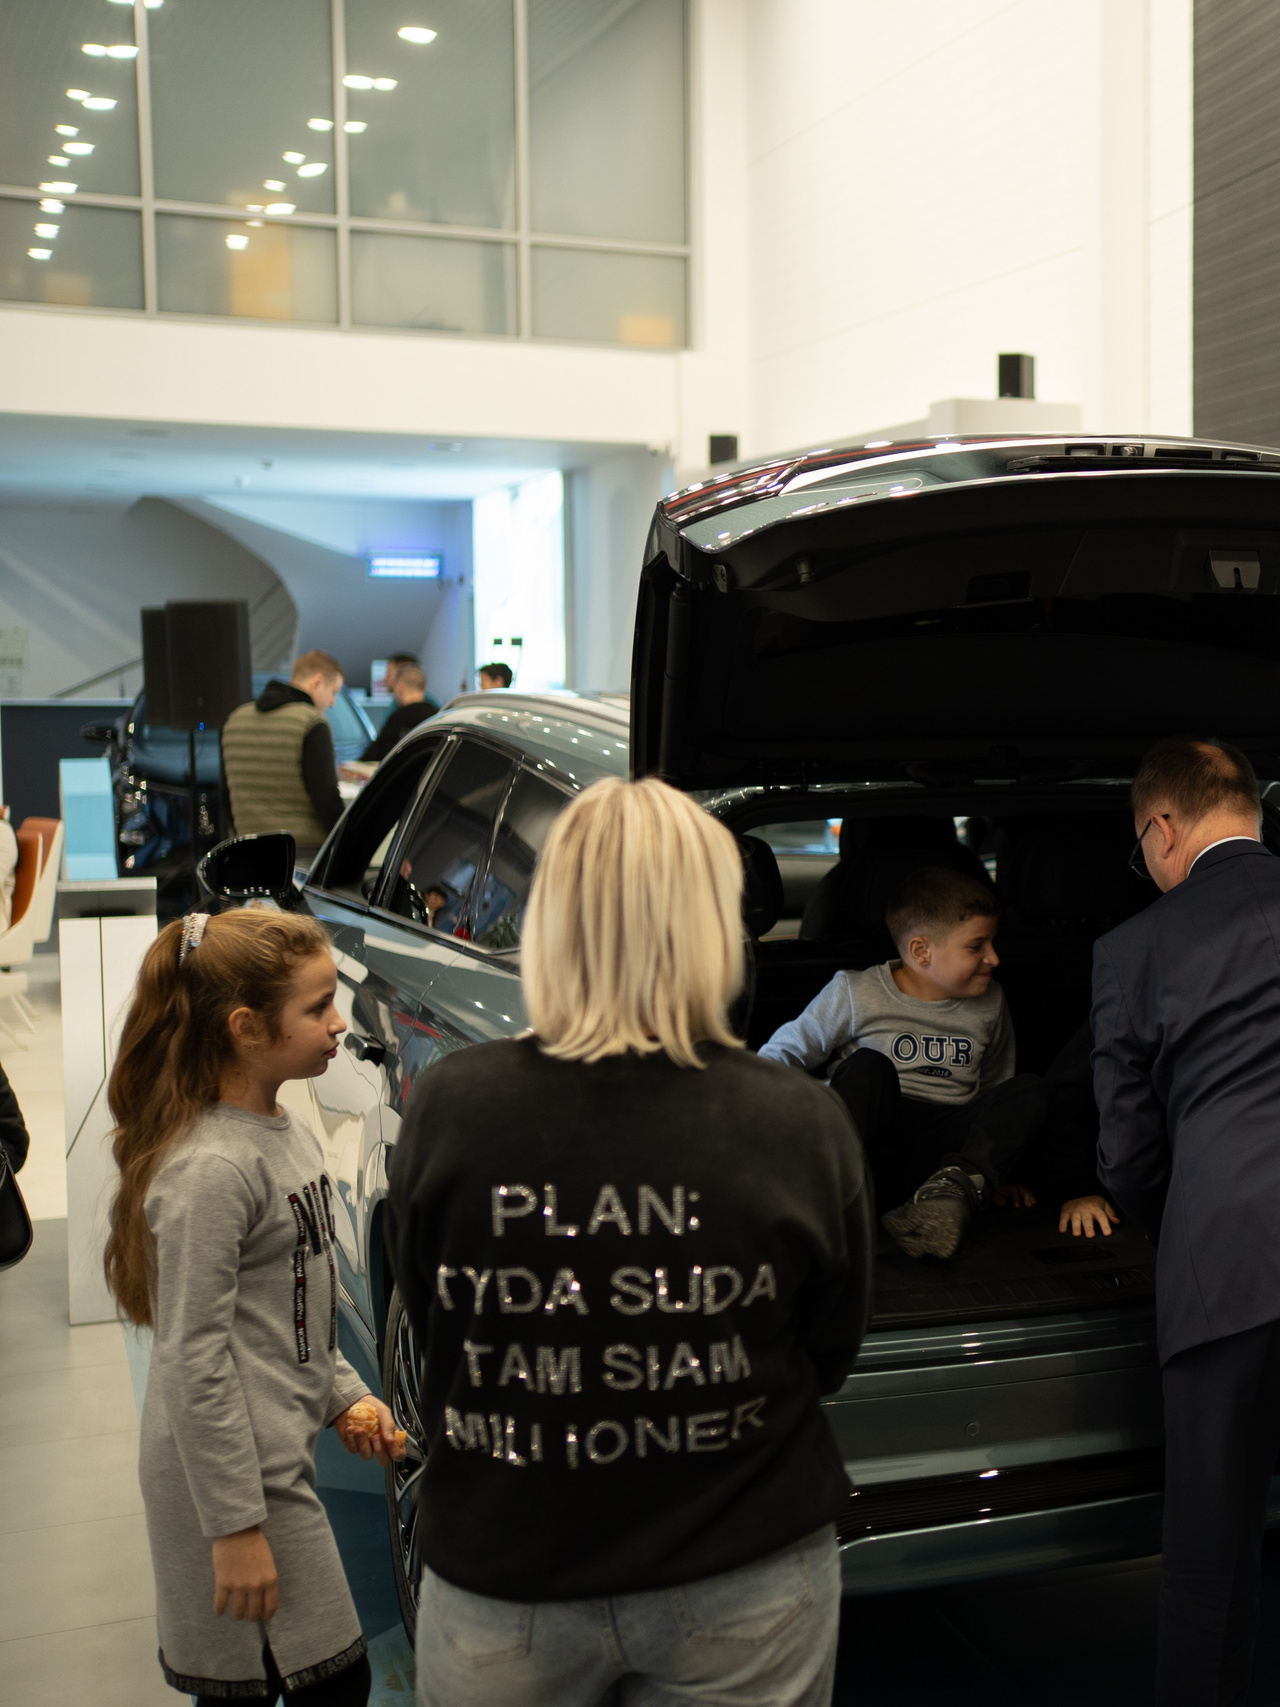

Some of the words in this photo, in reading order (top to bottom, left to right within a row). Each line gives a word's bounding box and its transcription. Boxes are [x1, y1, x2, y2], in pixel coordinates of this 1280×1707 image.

[891, 1032, 974, 1067] OUR
[491, 1183, 700, 1237] PLAN:
[610, 1263, 777, 1316] SUDA
[463, 1337, 582, 1395] TAM
[602, 1334, 752, 1391] SIAM
